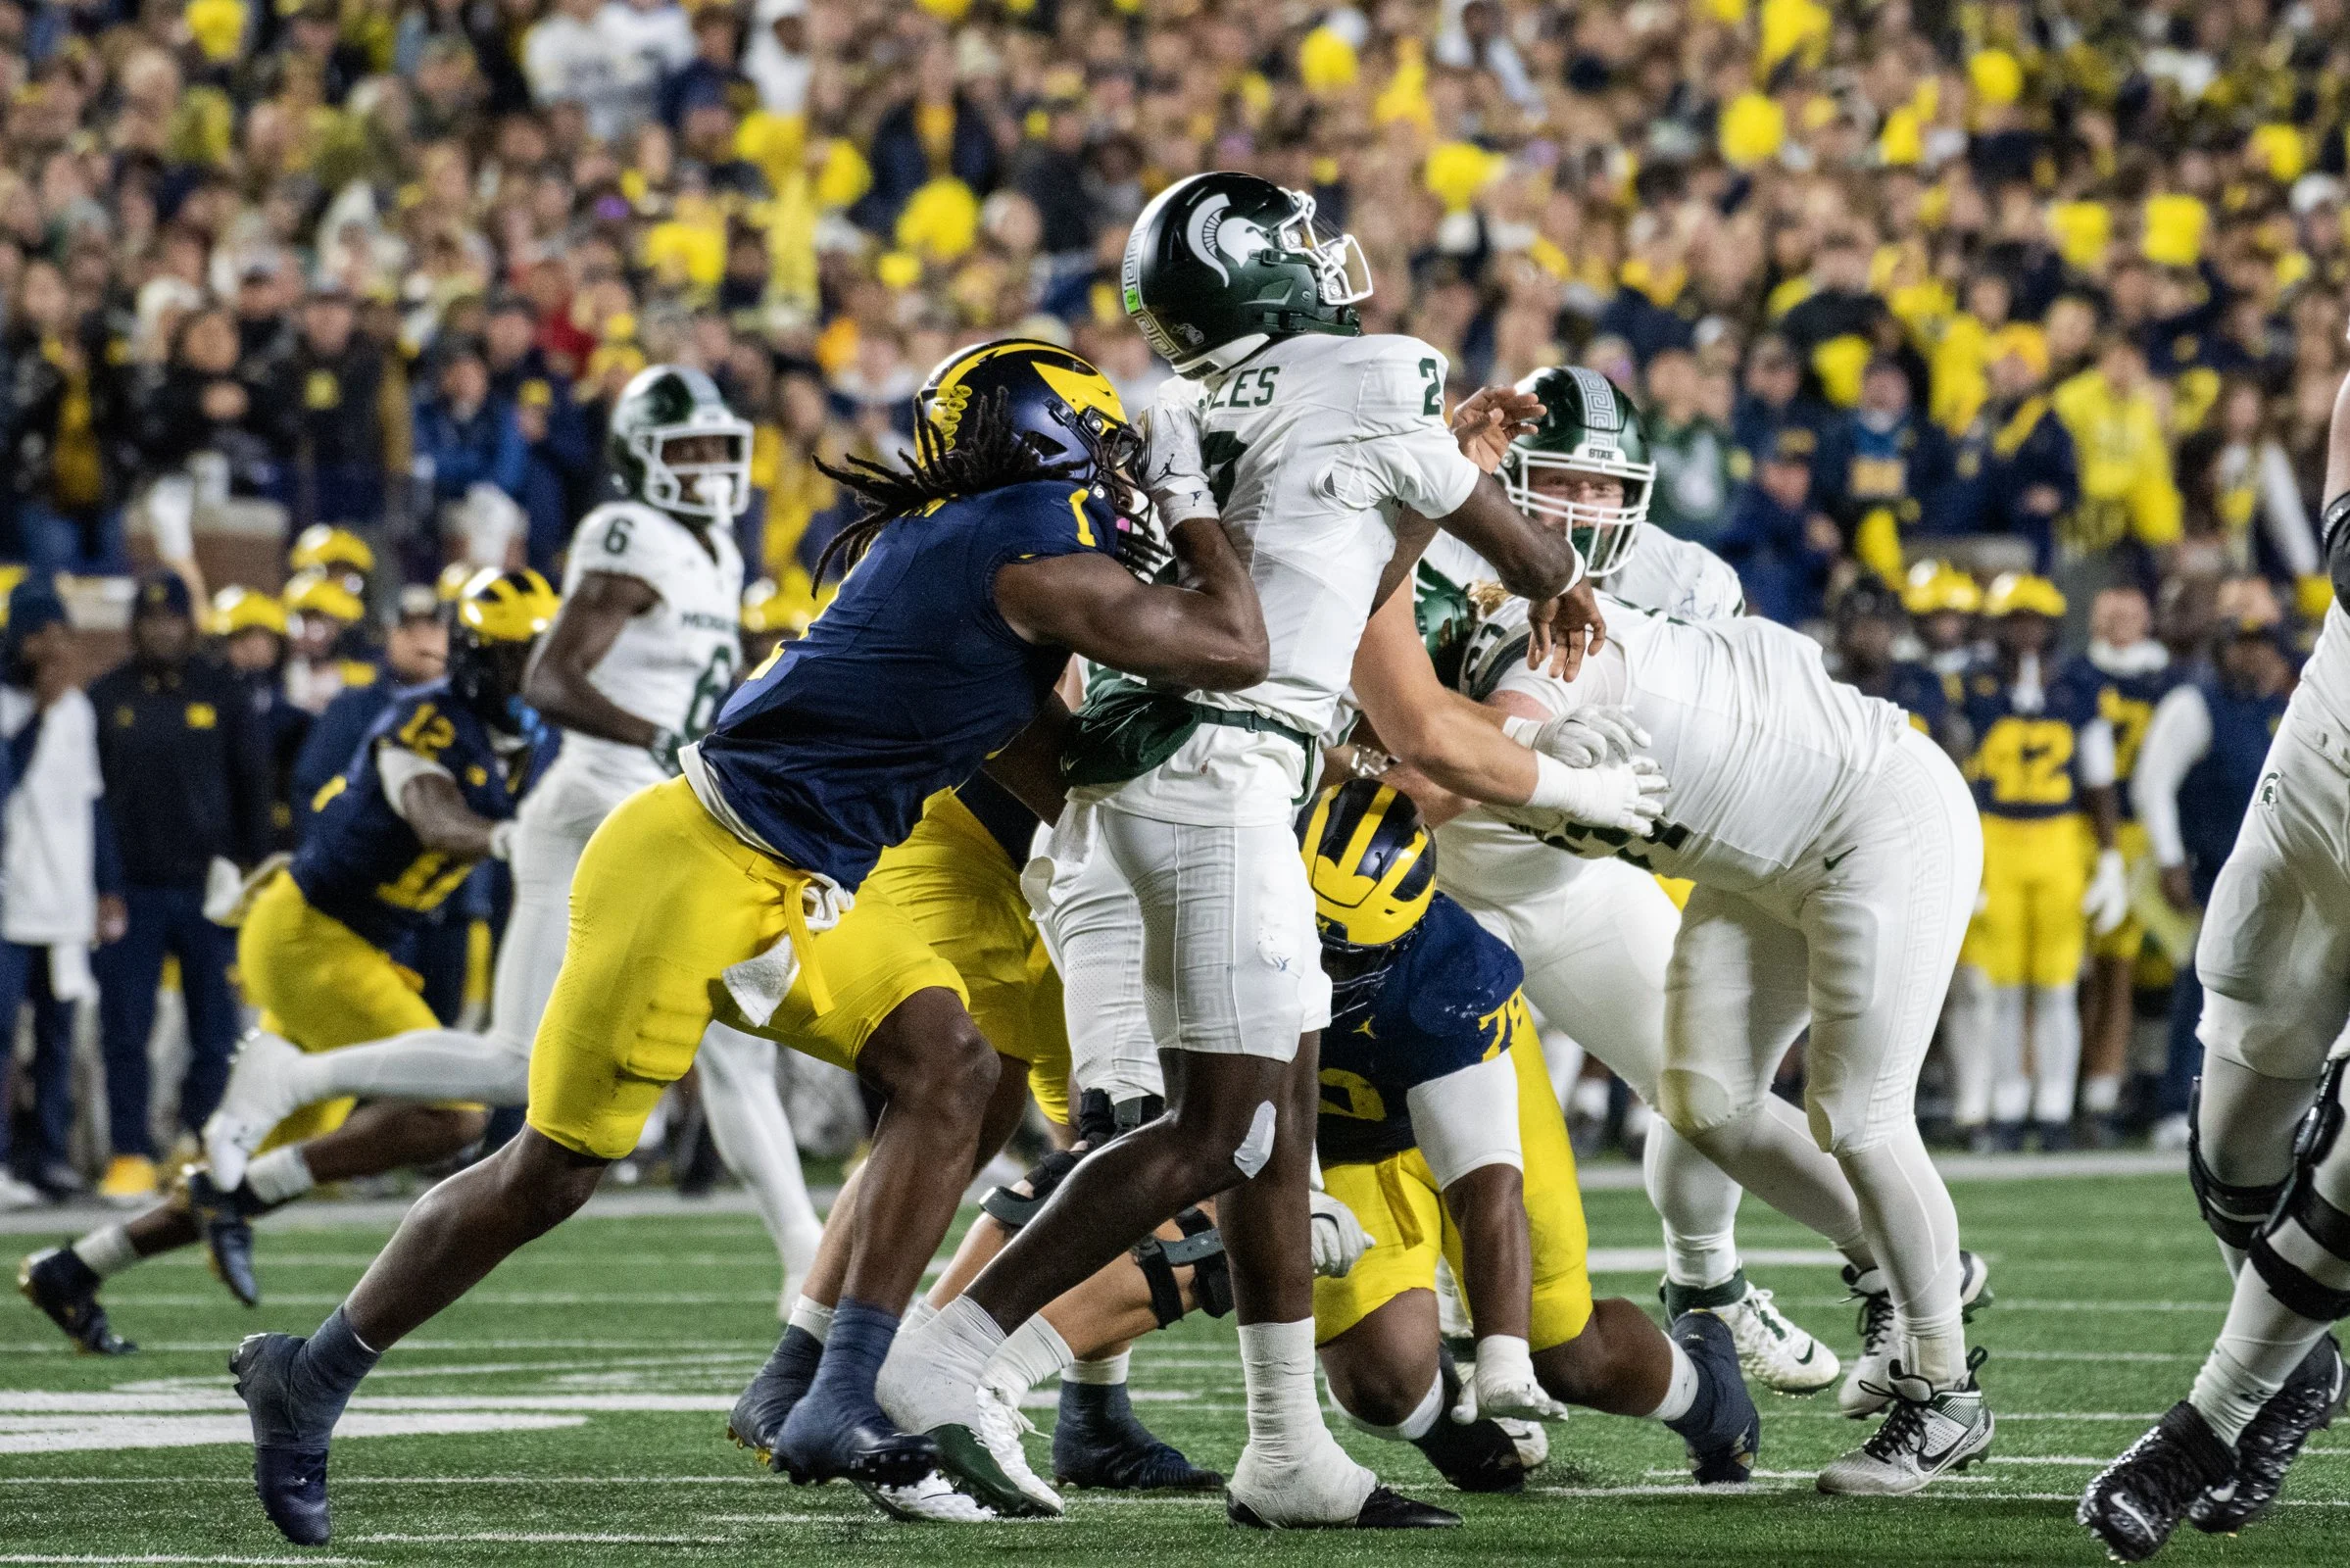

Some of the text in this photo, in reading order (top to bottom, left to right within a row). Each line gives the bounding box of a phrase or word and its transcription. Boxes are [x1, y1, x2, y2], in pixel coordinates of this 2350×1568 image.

[1199, 366, 1281, 411] LES
[1419, 358, 1442, 416] 2
[603, 517, 633, 556] 6
[1068, 488, 1096, 548] 1
[683, 645, 731, 741] 6
[400, 703, 454, 761] 12
[1962, 715, 2074, 805] 42
